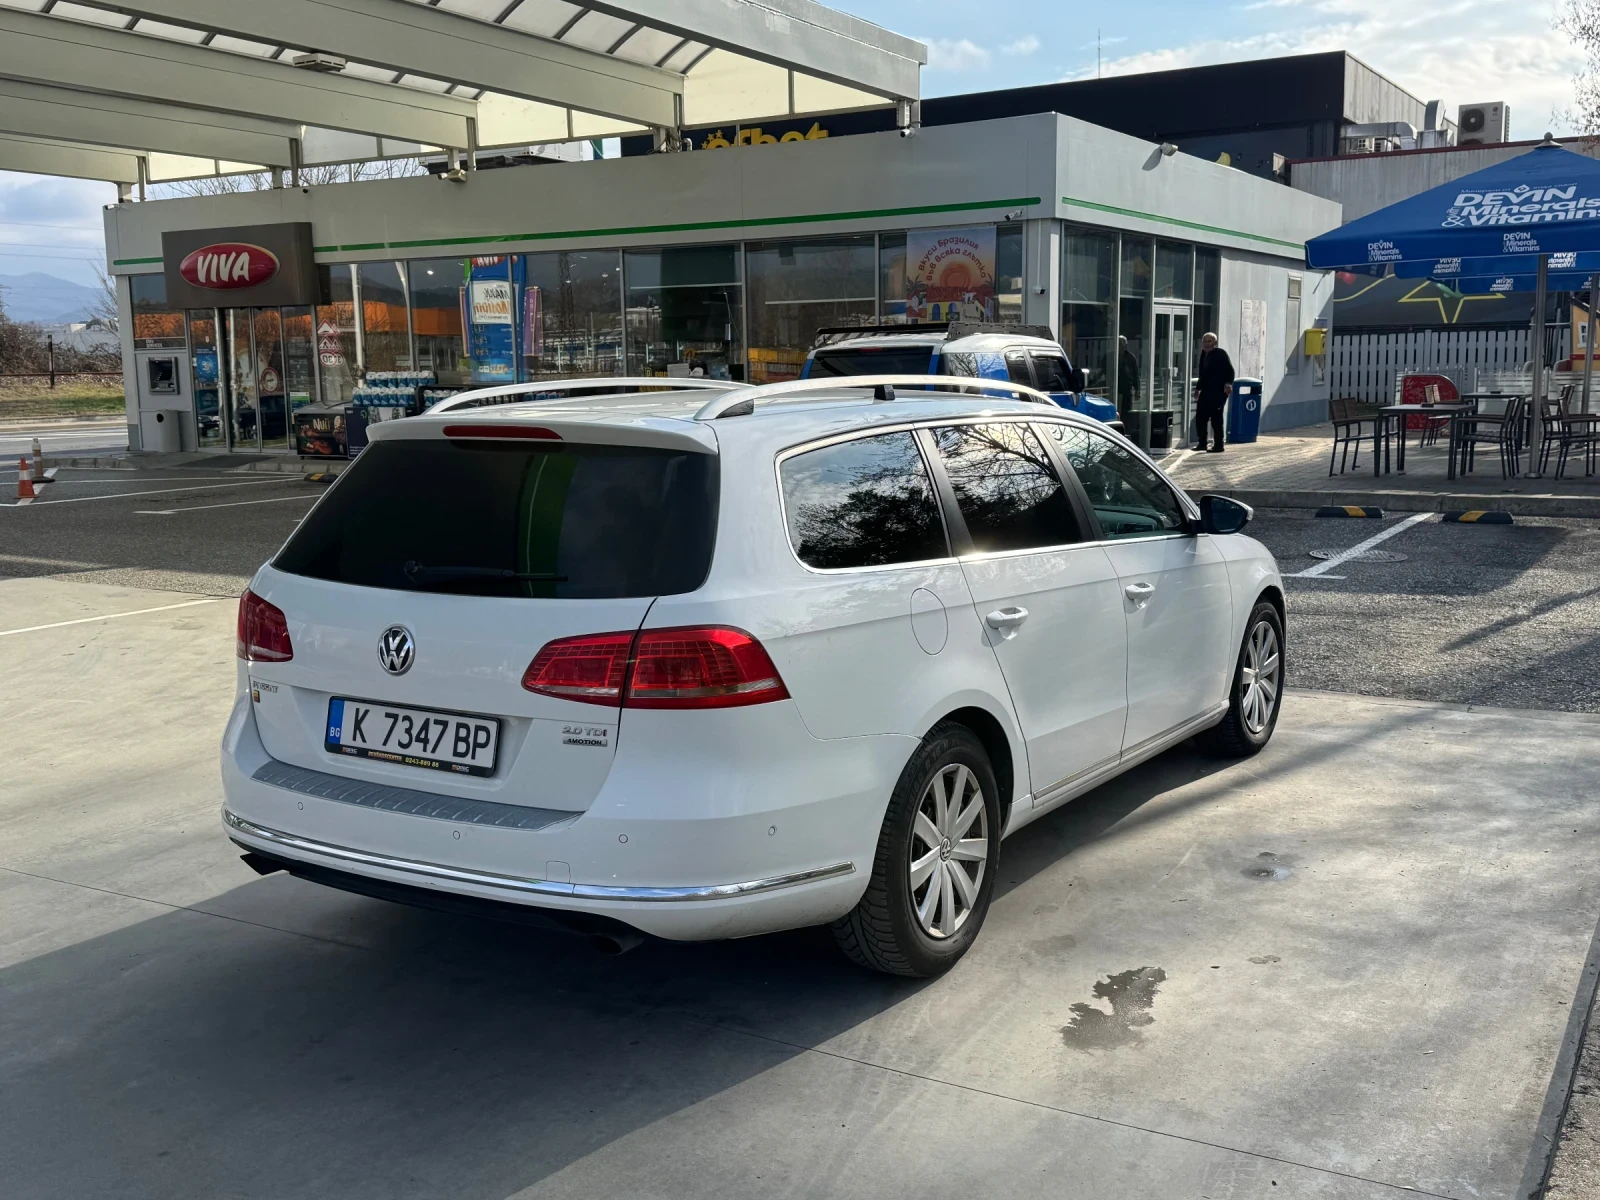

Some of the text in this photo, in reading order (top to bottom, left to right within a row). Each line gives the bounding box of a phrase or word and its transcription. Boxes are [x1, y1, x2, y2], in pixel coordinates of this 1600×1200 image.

[1453, 186, 1577, 207] DEVIN
[1460, 197, 1600, 216] Minerals
[1503, 231, 1531, 241] DEVIN
[1367, 241, 1394, 251] DEVIN
[1506, 238, 1538, 247] Minerals
[918, 236, 979, 272] Вкуси Бразилия
[1370, 247, 1400, 256] Minerals
[197, 251, 250, 283] VIVA
[934, 247, 961, 263] всяка
[962, 249, 987, 279] глътка
[329, 726, 341, 738] BG
[352, 707, 491, 761] K 7347 BP
[562, 725, 608, 737] 2.0 TDI
[566, 738, 602, 747] 4MOTION
